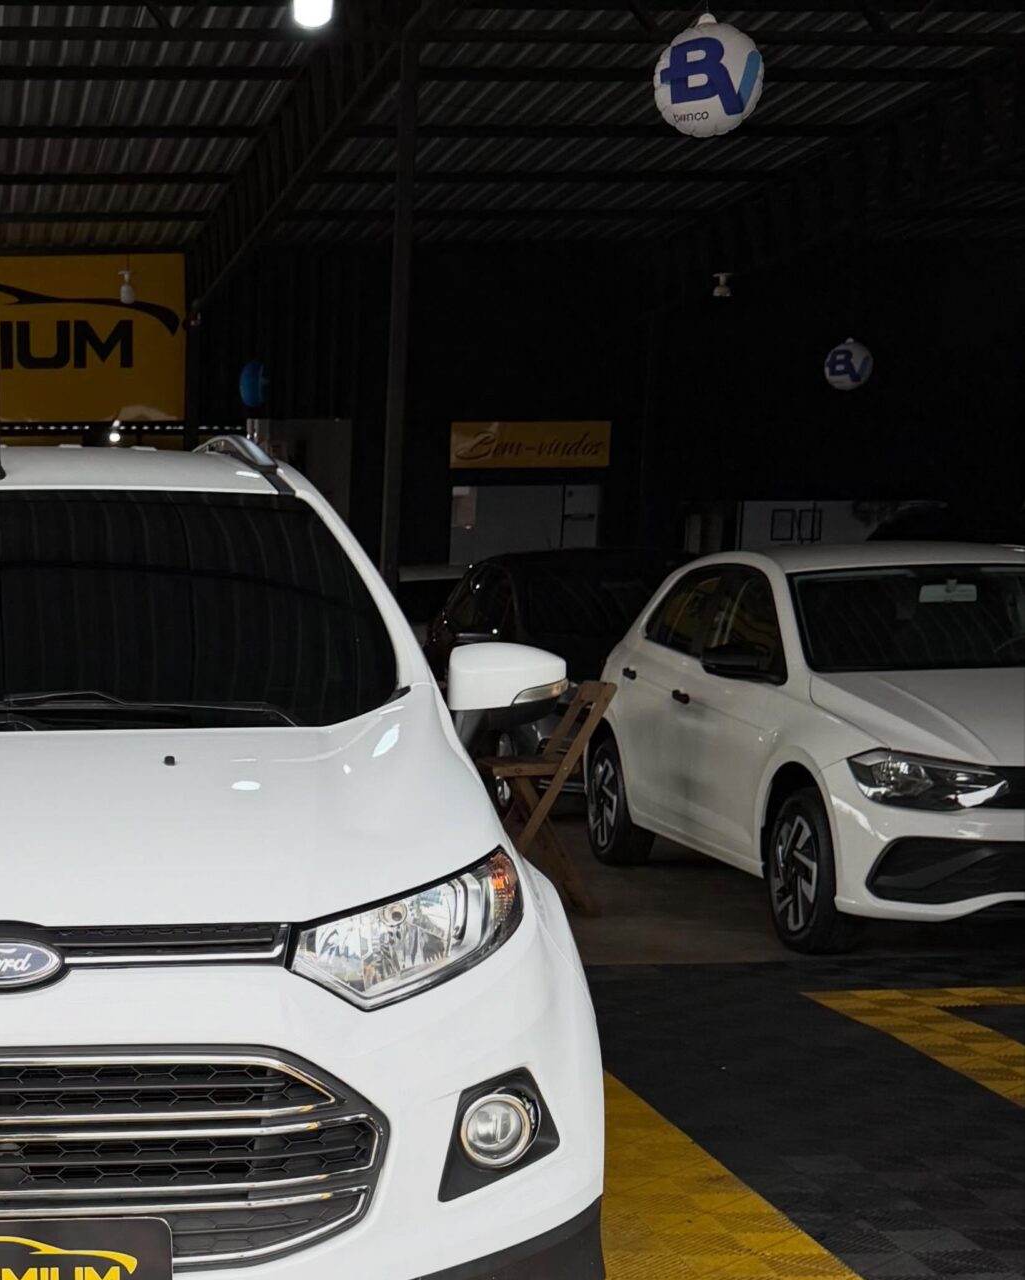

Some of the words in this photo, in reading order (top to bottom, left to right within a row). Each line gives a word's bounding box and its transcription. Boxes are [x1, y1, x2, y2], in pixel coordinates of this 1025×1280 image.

[660, 37, 761, 116] BV
[827, 350, 870, 383] BV
[456, 431, 604, 461] Bem-vindos
